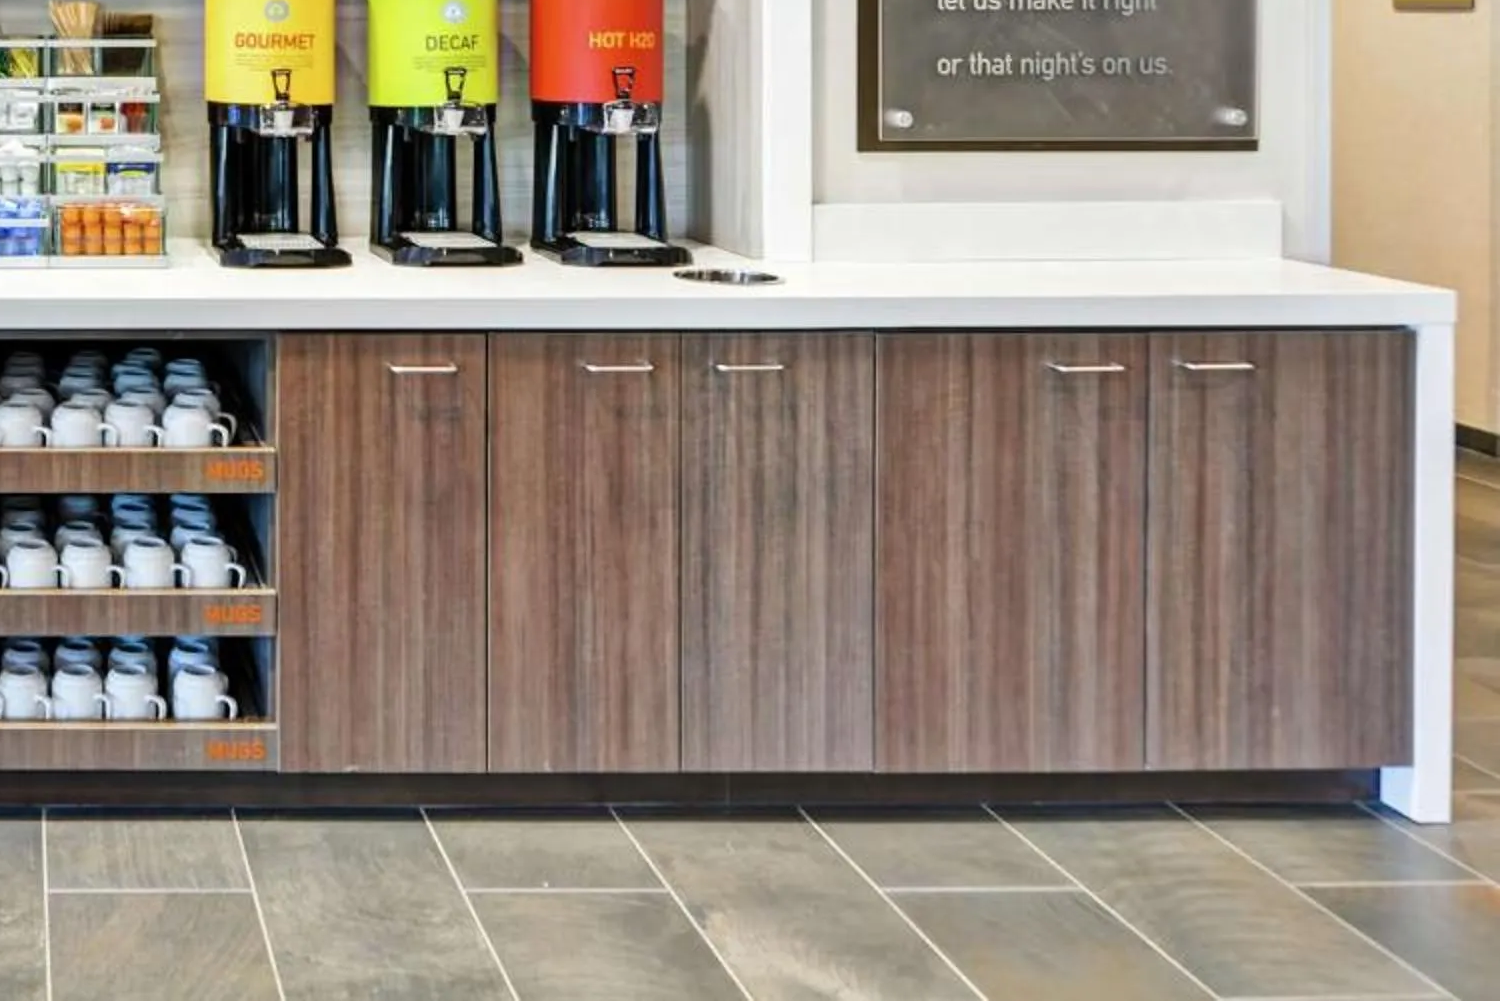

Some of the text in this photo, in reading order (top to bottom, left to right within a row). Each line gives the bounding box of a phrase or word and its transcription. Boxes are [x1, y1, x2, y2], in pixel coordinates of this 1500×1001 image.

[234, 32, 315, 50] GOURMET
[425, 34, 480, 51] DECAF
[588, 31, 625, 49] HOT
[936, 51, 1173, 81] or that night's on us.
